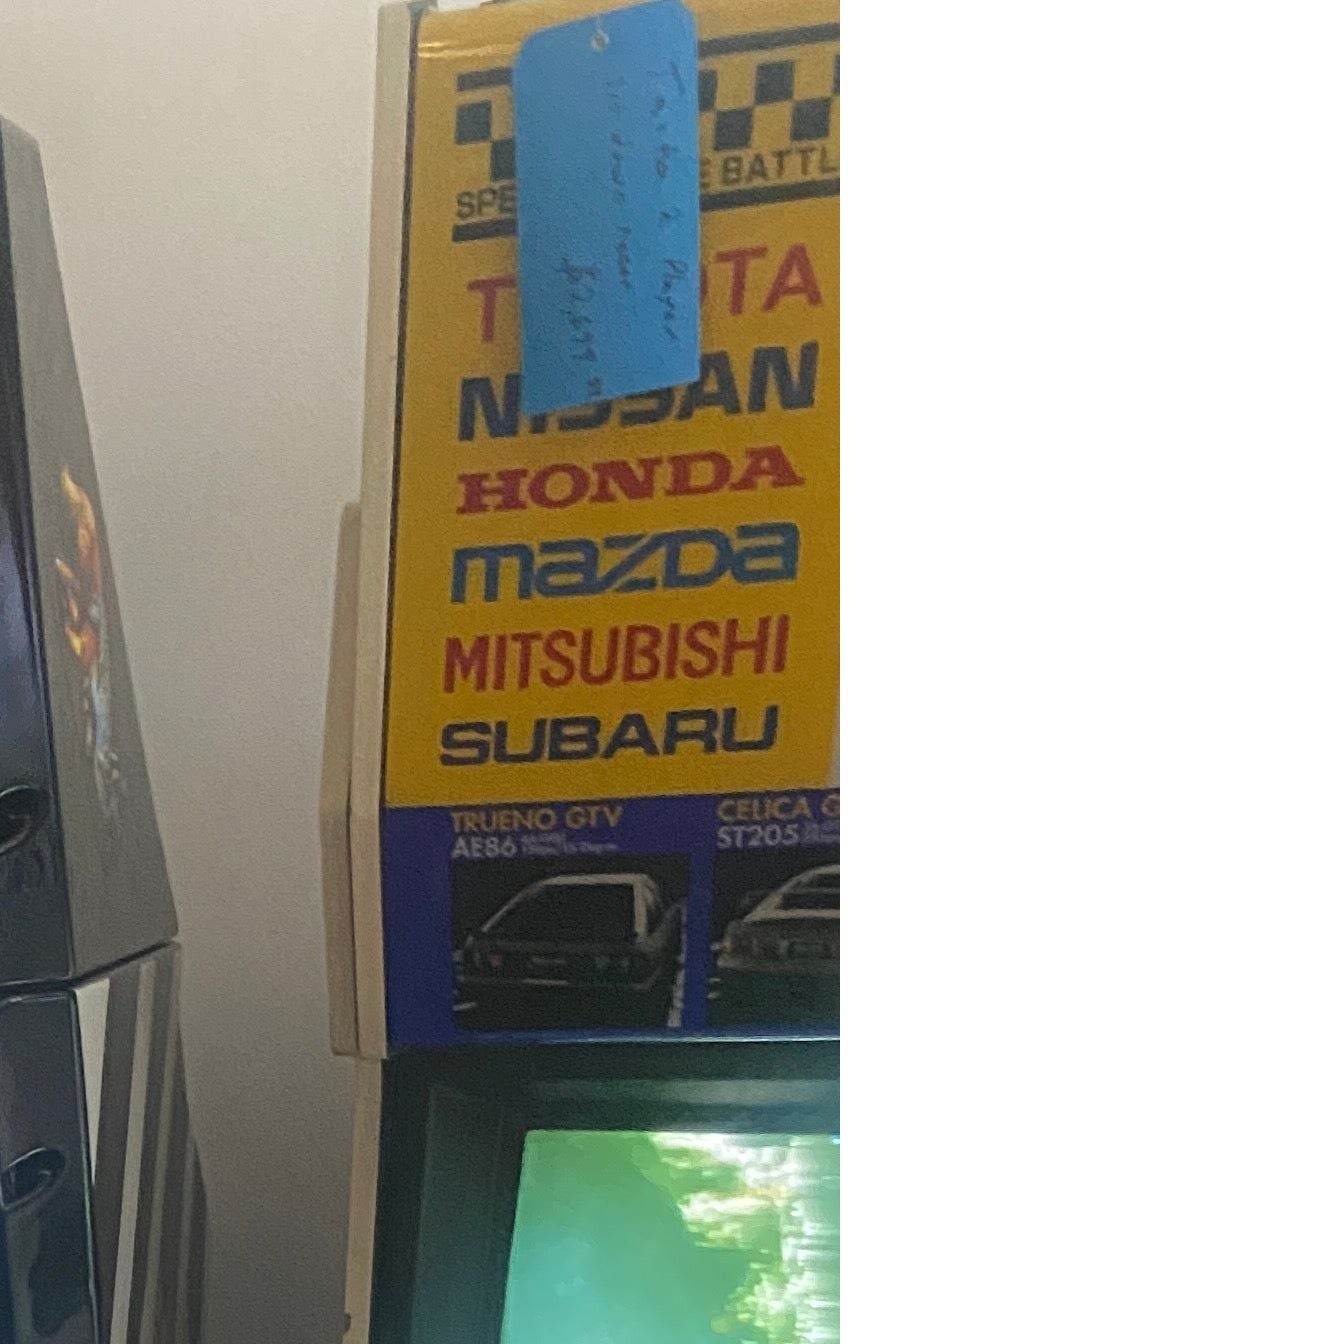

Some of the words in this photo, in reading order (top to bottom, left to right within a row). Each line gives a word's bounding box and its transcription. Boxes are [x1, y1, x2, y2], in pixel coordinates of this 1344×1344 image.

[457, 445, 805, 515] HONDA
[443, 614, 791, 694] MITSUBISHI
[439, 705, 779, 766] SUBARU
[451, 808, 557, 833] TRUENO
[717, 798, 810, 823] CELICA
[451, 836, 518, 859] AE86
[717, 823, 799, 850] ST205
